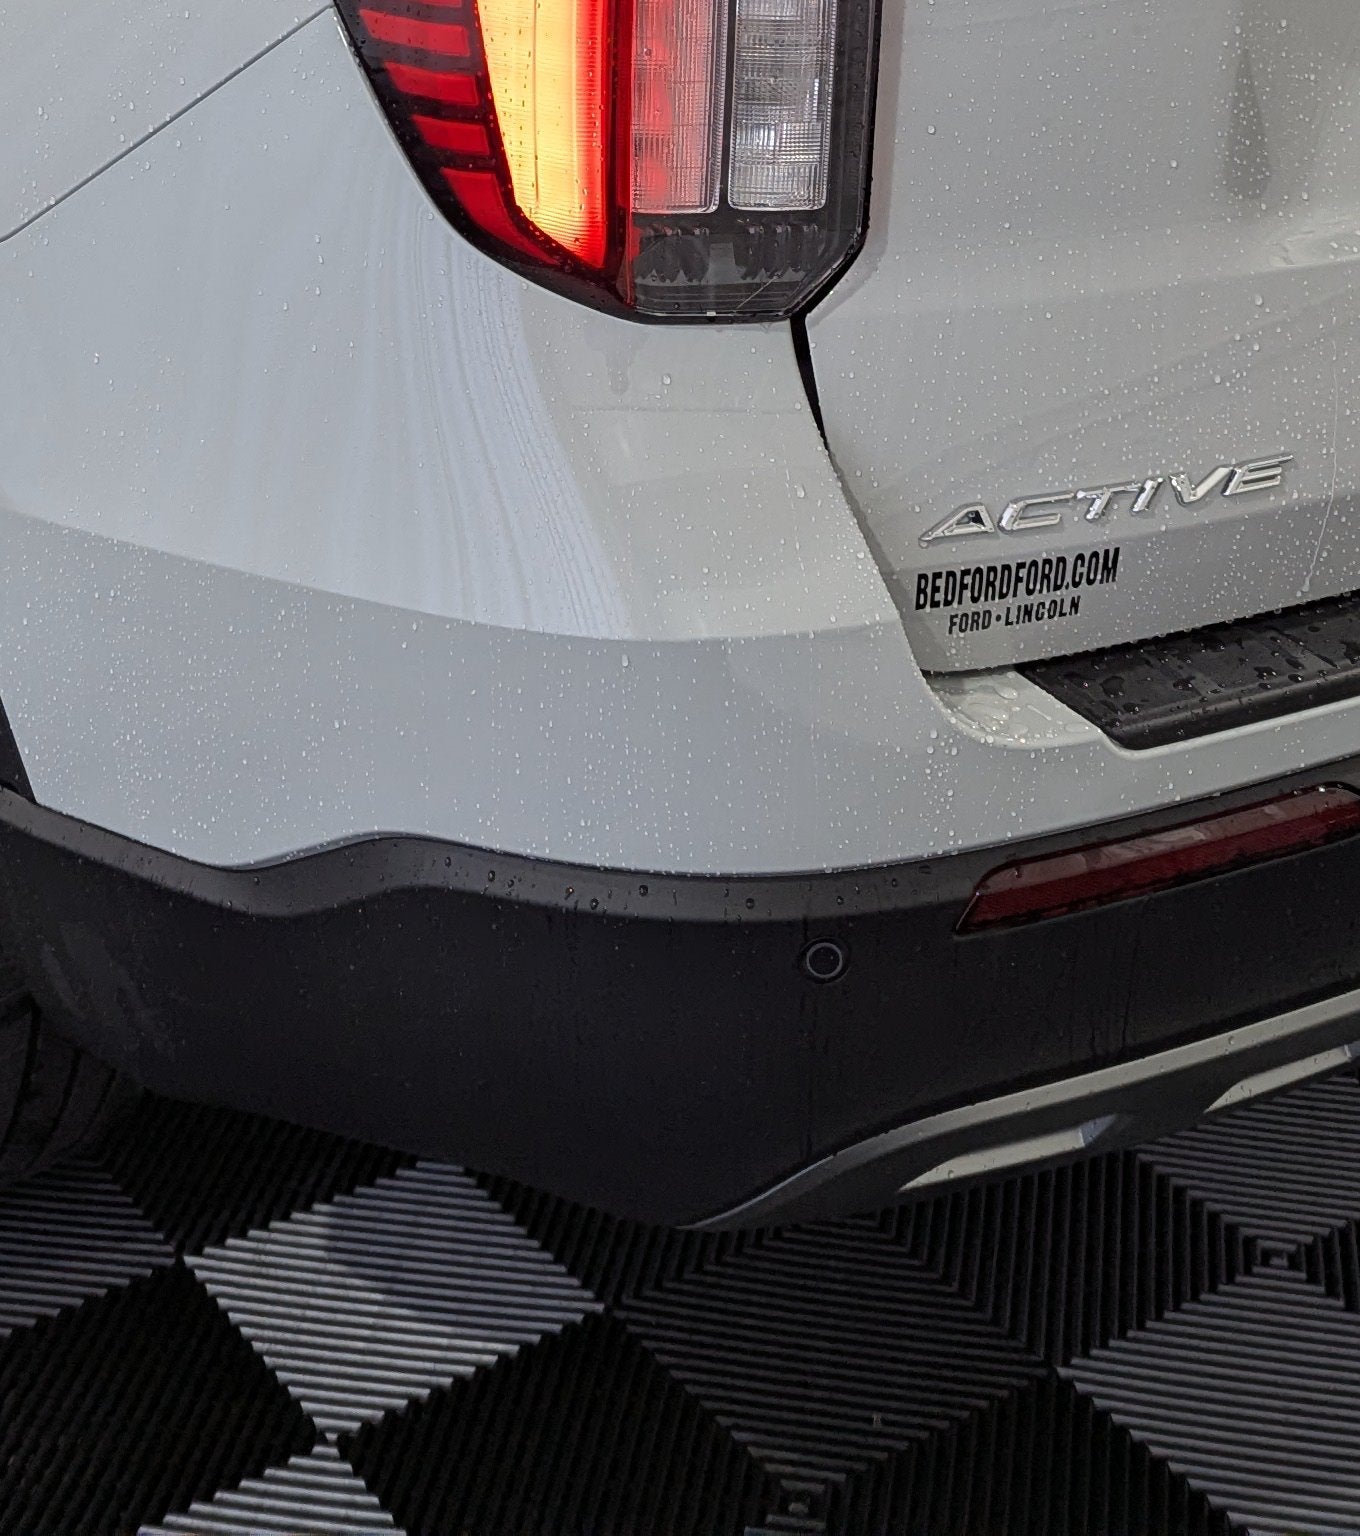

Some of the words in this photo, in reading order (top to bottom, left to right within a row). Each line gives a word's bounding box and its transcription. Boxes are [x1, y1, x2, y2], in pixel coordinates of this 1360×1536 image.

[918, 452, 1296, 545] ACTIVE
[915, 547, 1120, 611] BEDFORDFORD.COM
[948, 609, 992, 635] FORD
[1004, 595, 1081, 627] LINCOLN
